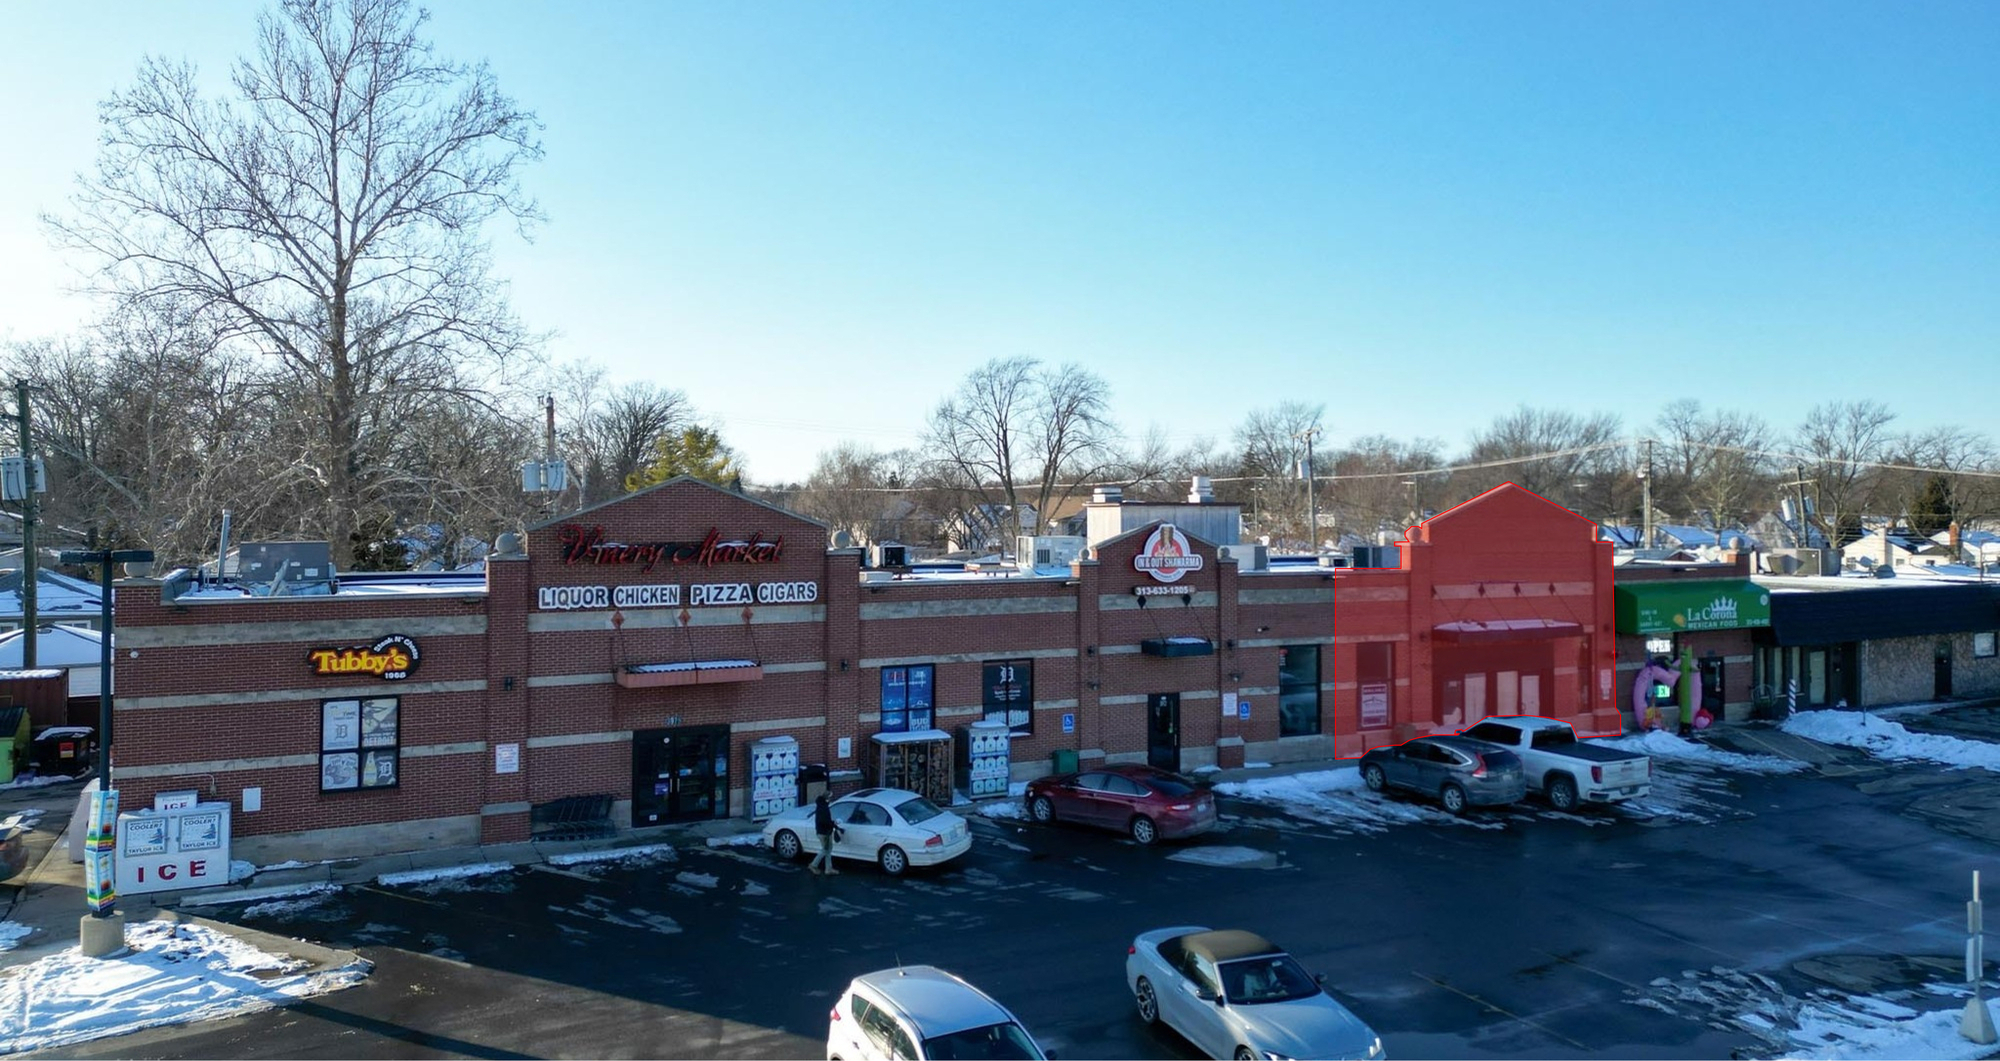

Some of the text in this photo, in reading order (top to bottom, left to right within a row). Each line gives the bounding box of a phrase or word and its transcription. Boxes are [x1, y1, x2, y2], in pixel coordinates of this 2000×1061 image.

[558, 523, 785, 574] Vinery Market
[1137, 557, 1144, 567] IN
[1151, 557, 1163, 567] OUT
[1164, 557, 1200, 567] SHAWARMA
[540, 583, 816, 608] LIQUOR CHICKEN PIZZA CIGARS
[1688, 607, 1737, 621] La Corona
[1688, 621, 1718, 629] MEXICAN
[1646, 639, 1671, 653] OPEN
[313, 648, 408, 675] Tubby's
[130, 823, 163, 831] COOLER?
[184, 818, 216, 826] COOLER?
[138, 860, 206, 883] ICE
